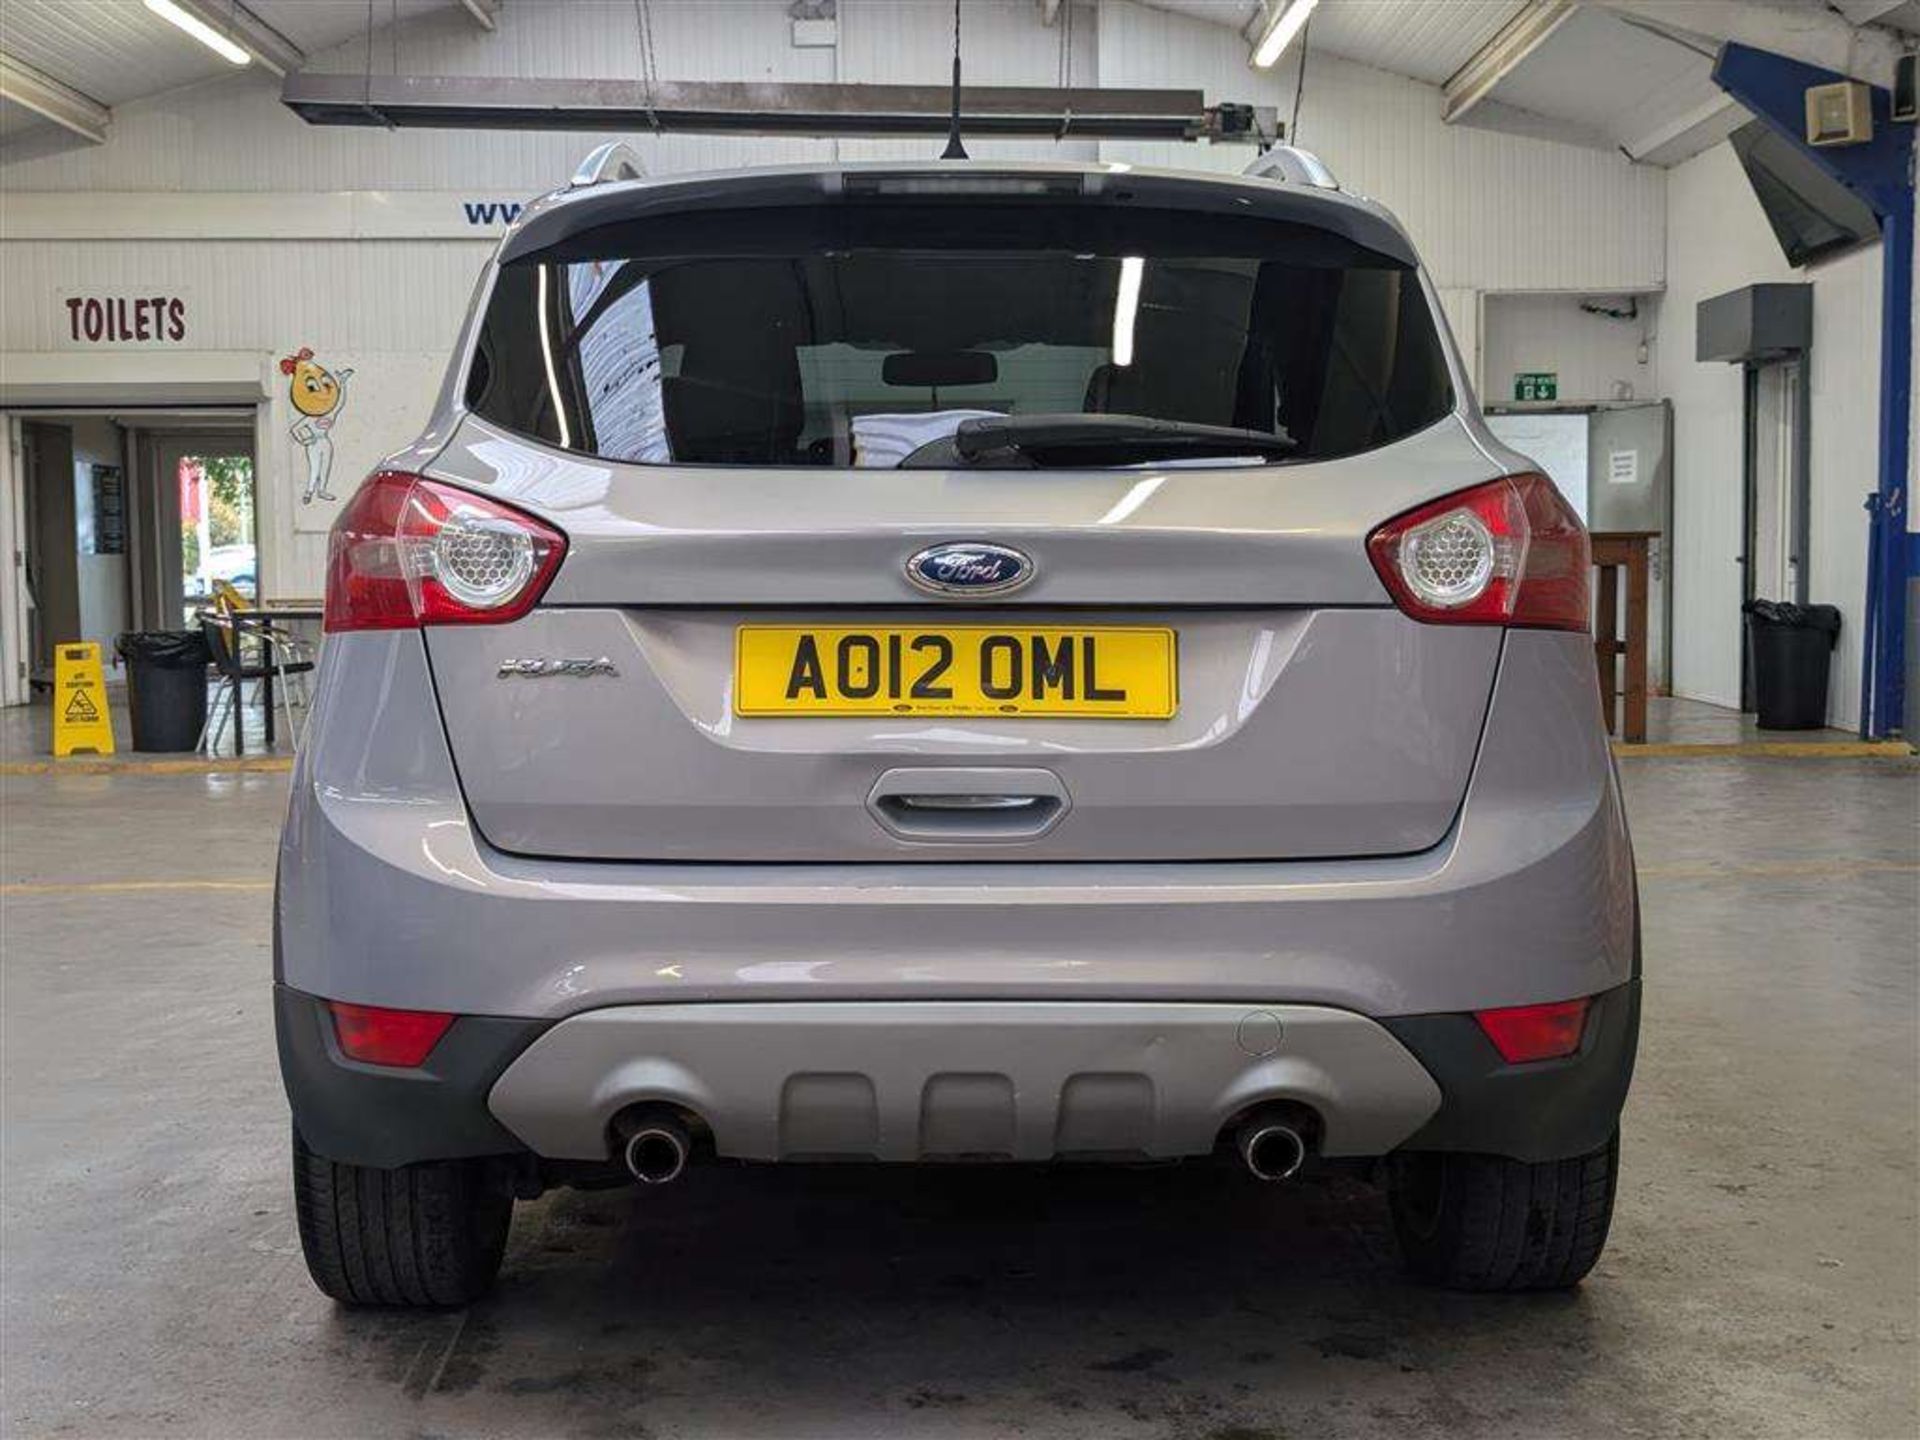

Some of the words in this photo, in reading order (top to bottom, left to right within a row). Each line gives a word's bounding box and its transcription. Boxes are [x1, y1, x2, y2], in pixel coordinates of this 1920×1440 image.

[66, 297, 185, 341] TOILETS
[933, 552, 1003, 580] Ford
[785, 635, 954, 698] AO12
[980, 635, 1126, 701] OML
